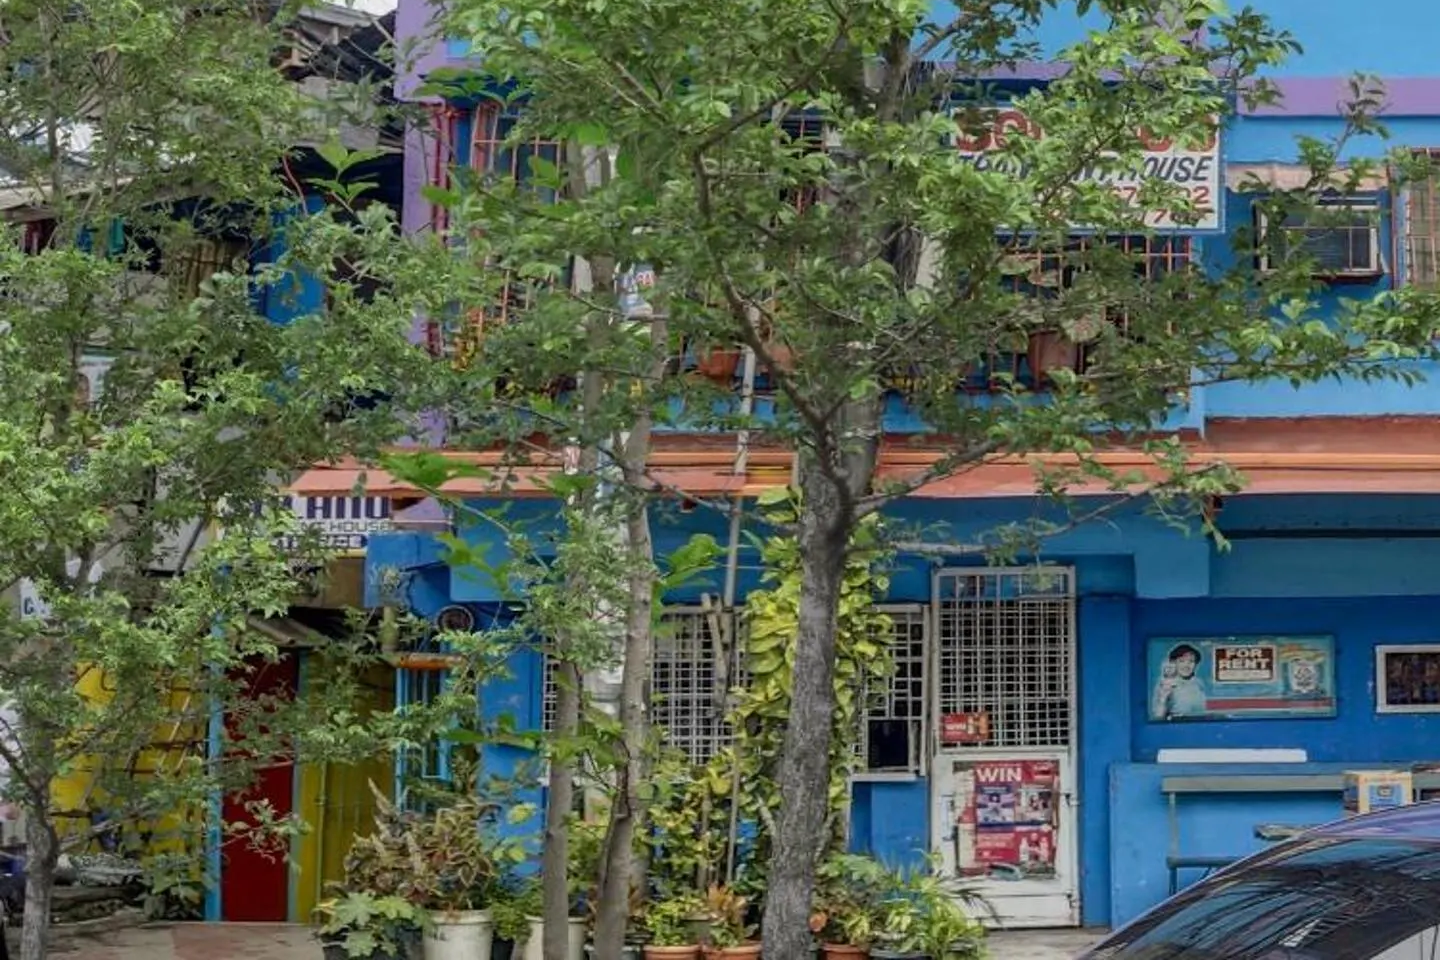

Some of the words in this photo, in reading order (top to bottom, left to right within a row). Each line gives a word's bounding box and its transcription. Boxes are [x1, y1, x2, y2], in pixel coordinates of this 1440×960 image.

[1226, 648, 1263, 658] FOR
[1218, 658, 1271, 670] RENT
[976, 767, 1022, 782] WIN
